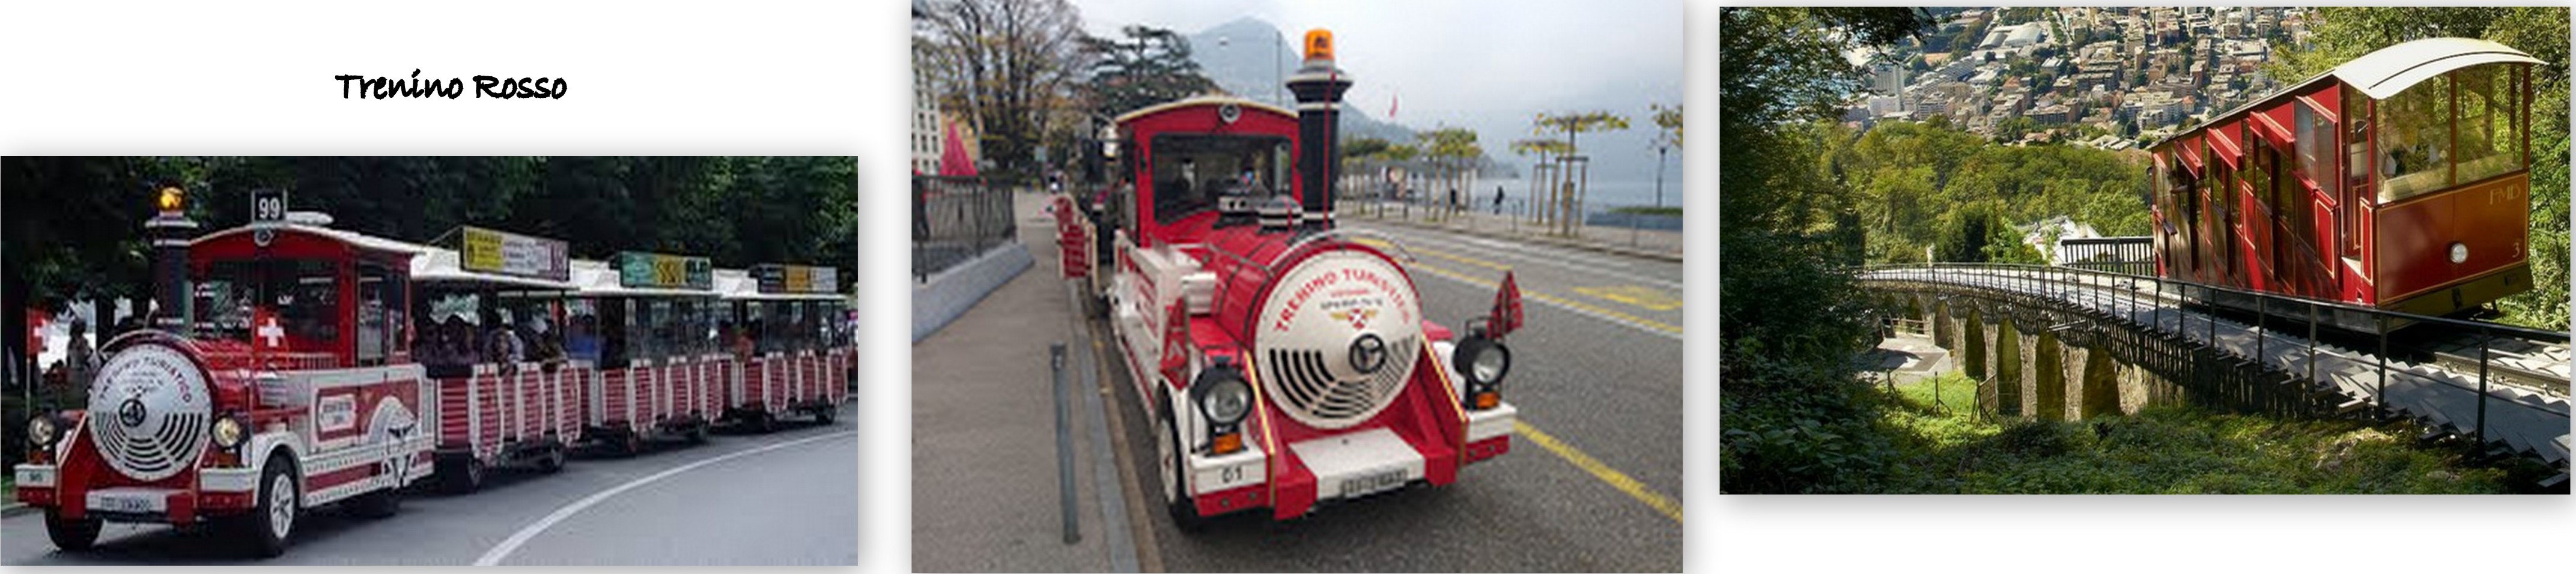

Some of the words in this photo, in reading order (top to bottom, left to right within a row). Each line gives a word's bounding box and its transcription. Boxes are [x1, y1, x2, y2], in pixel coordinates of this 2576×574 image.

[259, 197, 281, 219] 99
[2512, 242, 2520, 258] 3
[1272, 271, 1338, 331] TRENINO
[1222, 467, 1242, 483] 01
